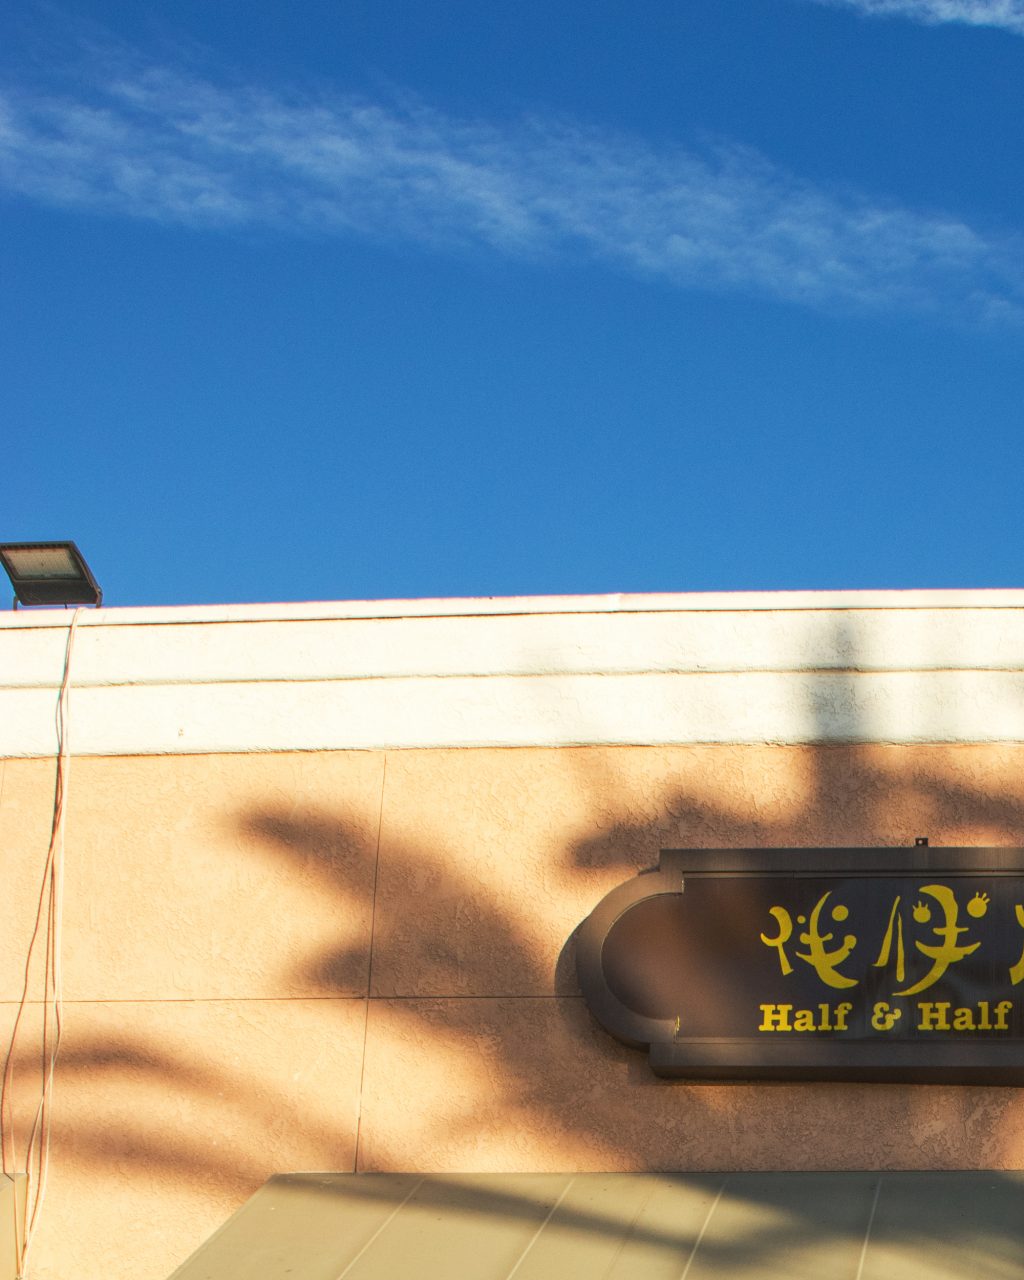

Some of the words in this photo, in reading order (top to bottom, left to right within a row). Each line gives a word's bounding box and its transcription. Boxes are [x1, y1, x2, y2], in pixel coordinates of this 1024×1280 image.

[759, 1002, 853, 1032] Half
[872, 1002, 902, 1032] &
[918, 1002, 1013, 1031] Half
